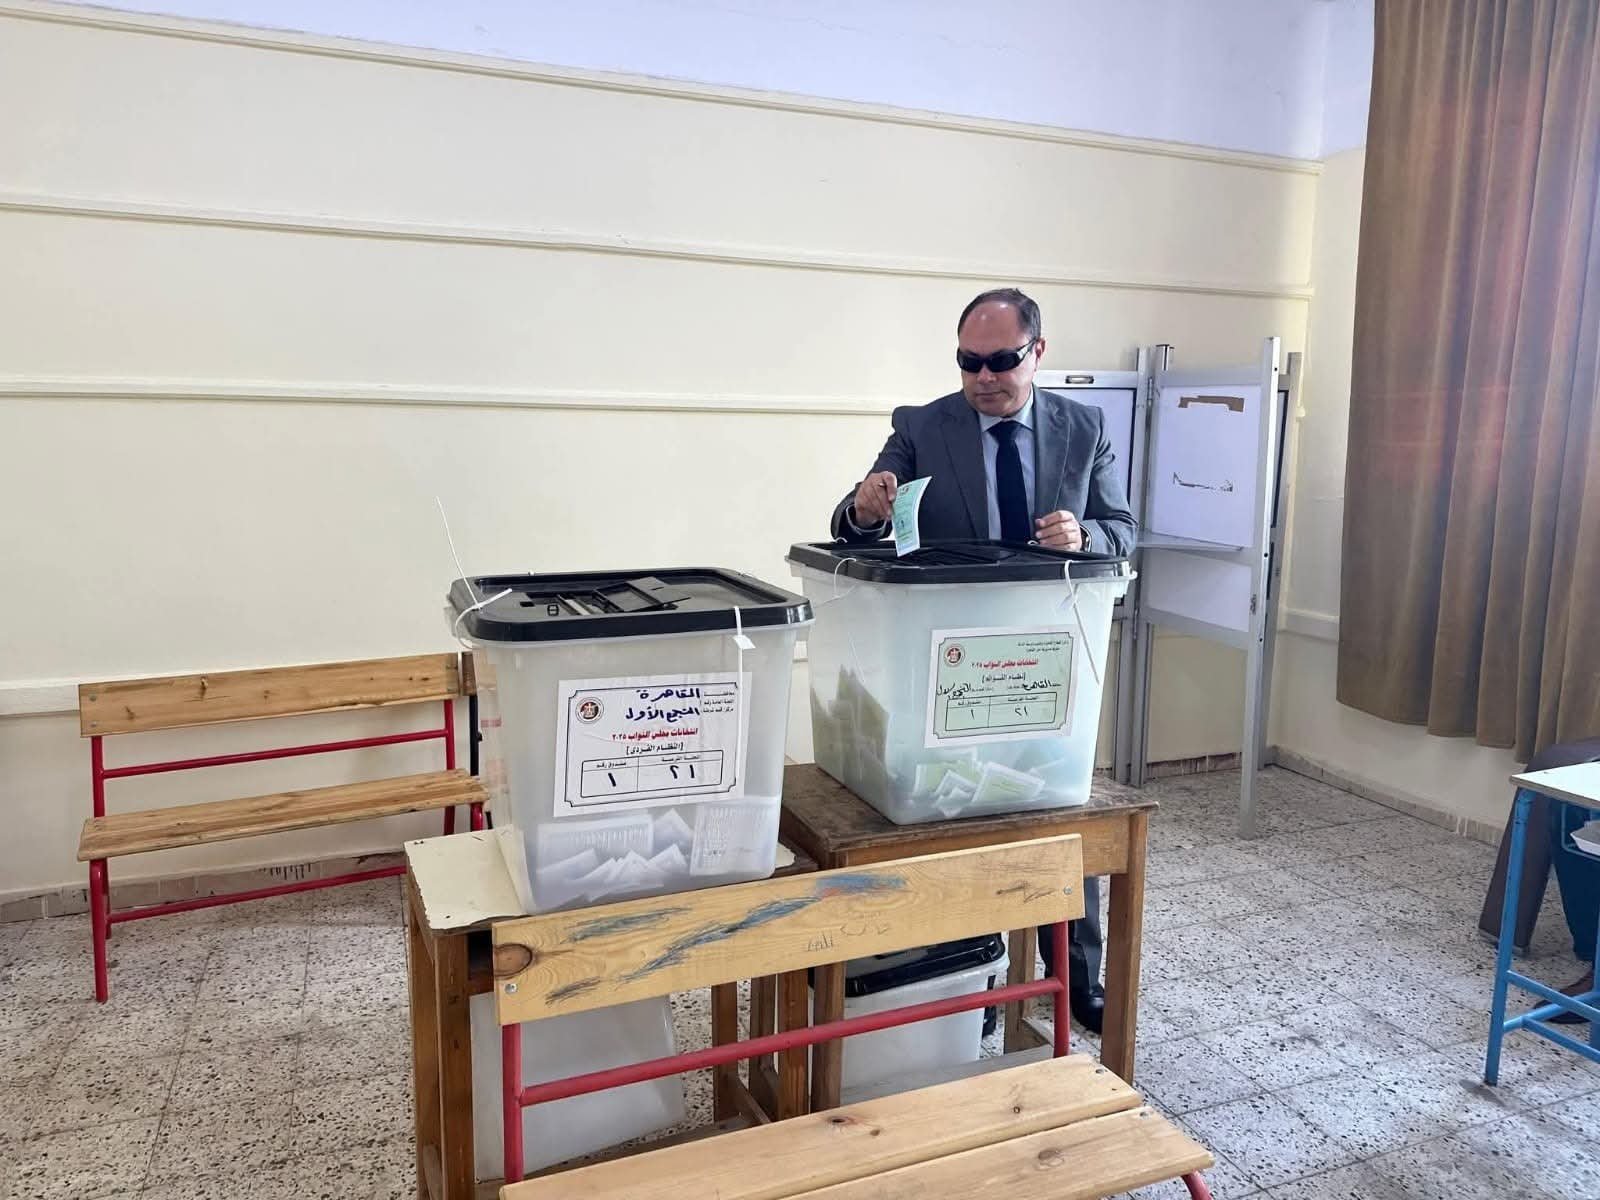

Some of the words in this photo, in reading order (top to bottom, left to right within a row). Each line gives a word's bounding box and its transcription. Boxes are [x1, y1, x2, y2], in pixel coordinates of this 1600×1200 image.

[636, 687, 701, 702] القاهرة
[625, 706, 665, 721] الأول
[612, 733, 627, 741] ٢٠٢٥
[628, 730, 651, 741] النواب
[652, 729, 670, 740] مجلس
[670, 727, 699, 737] انتخابات
